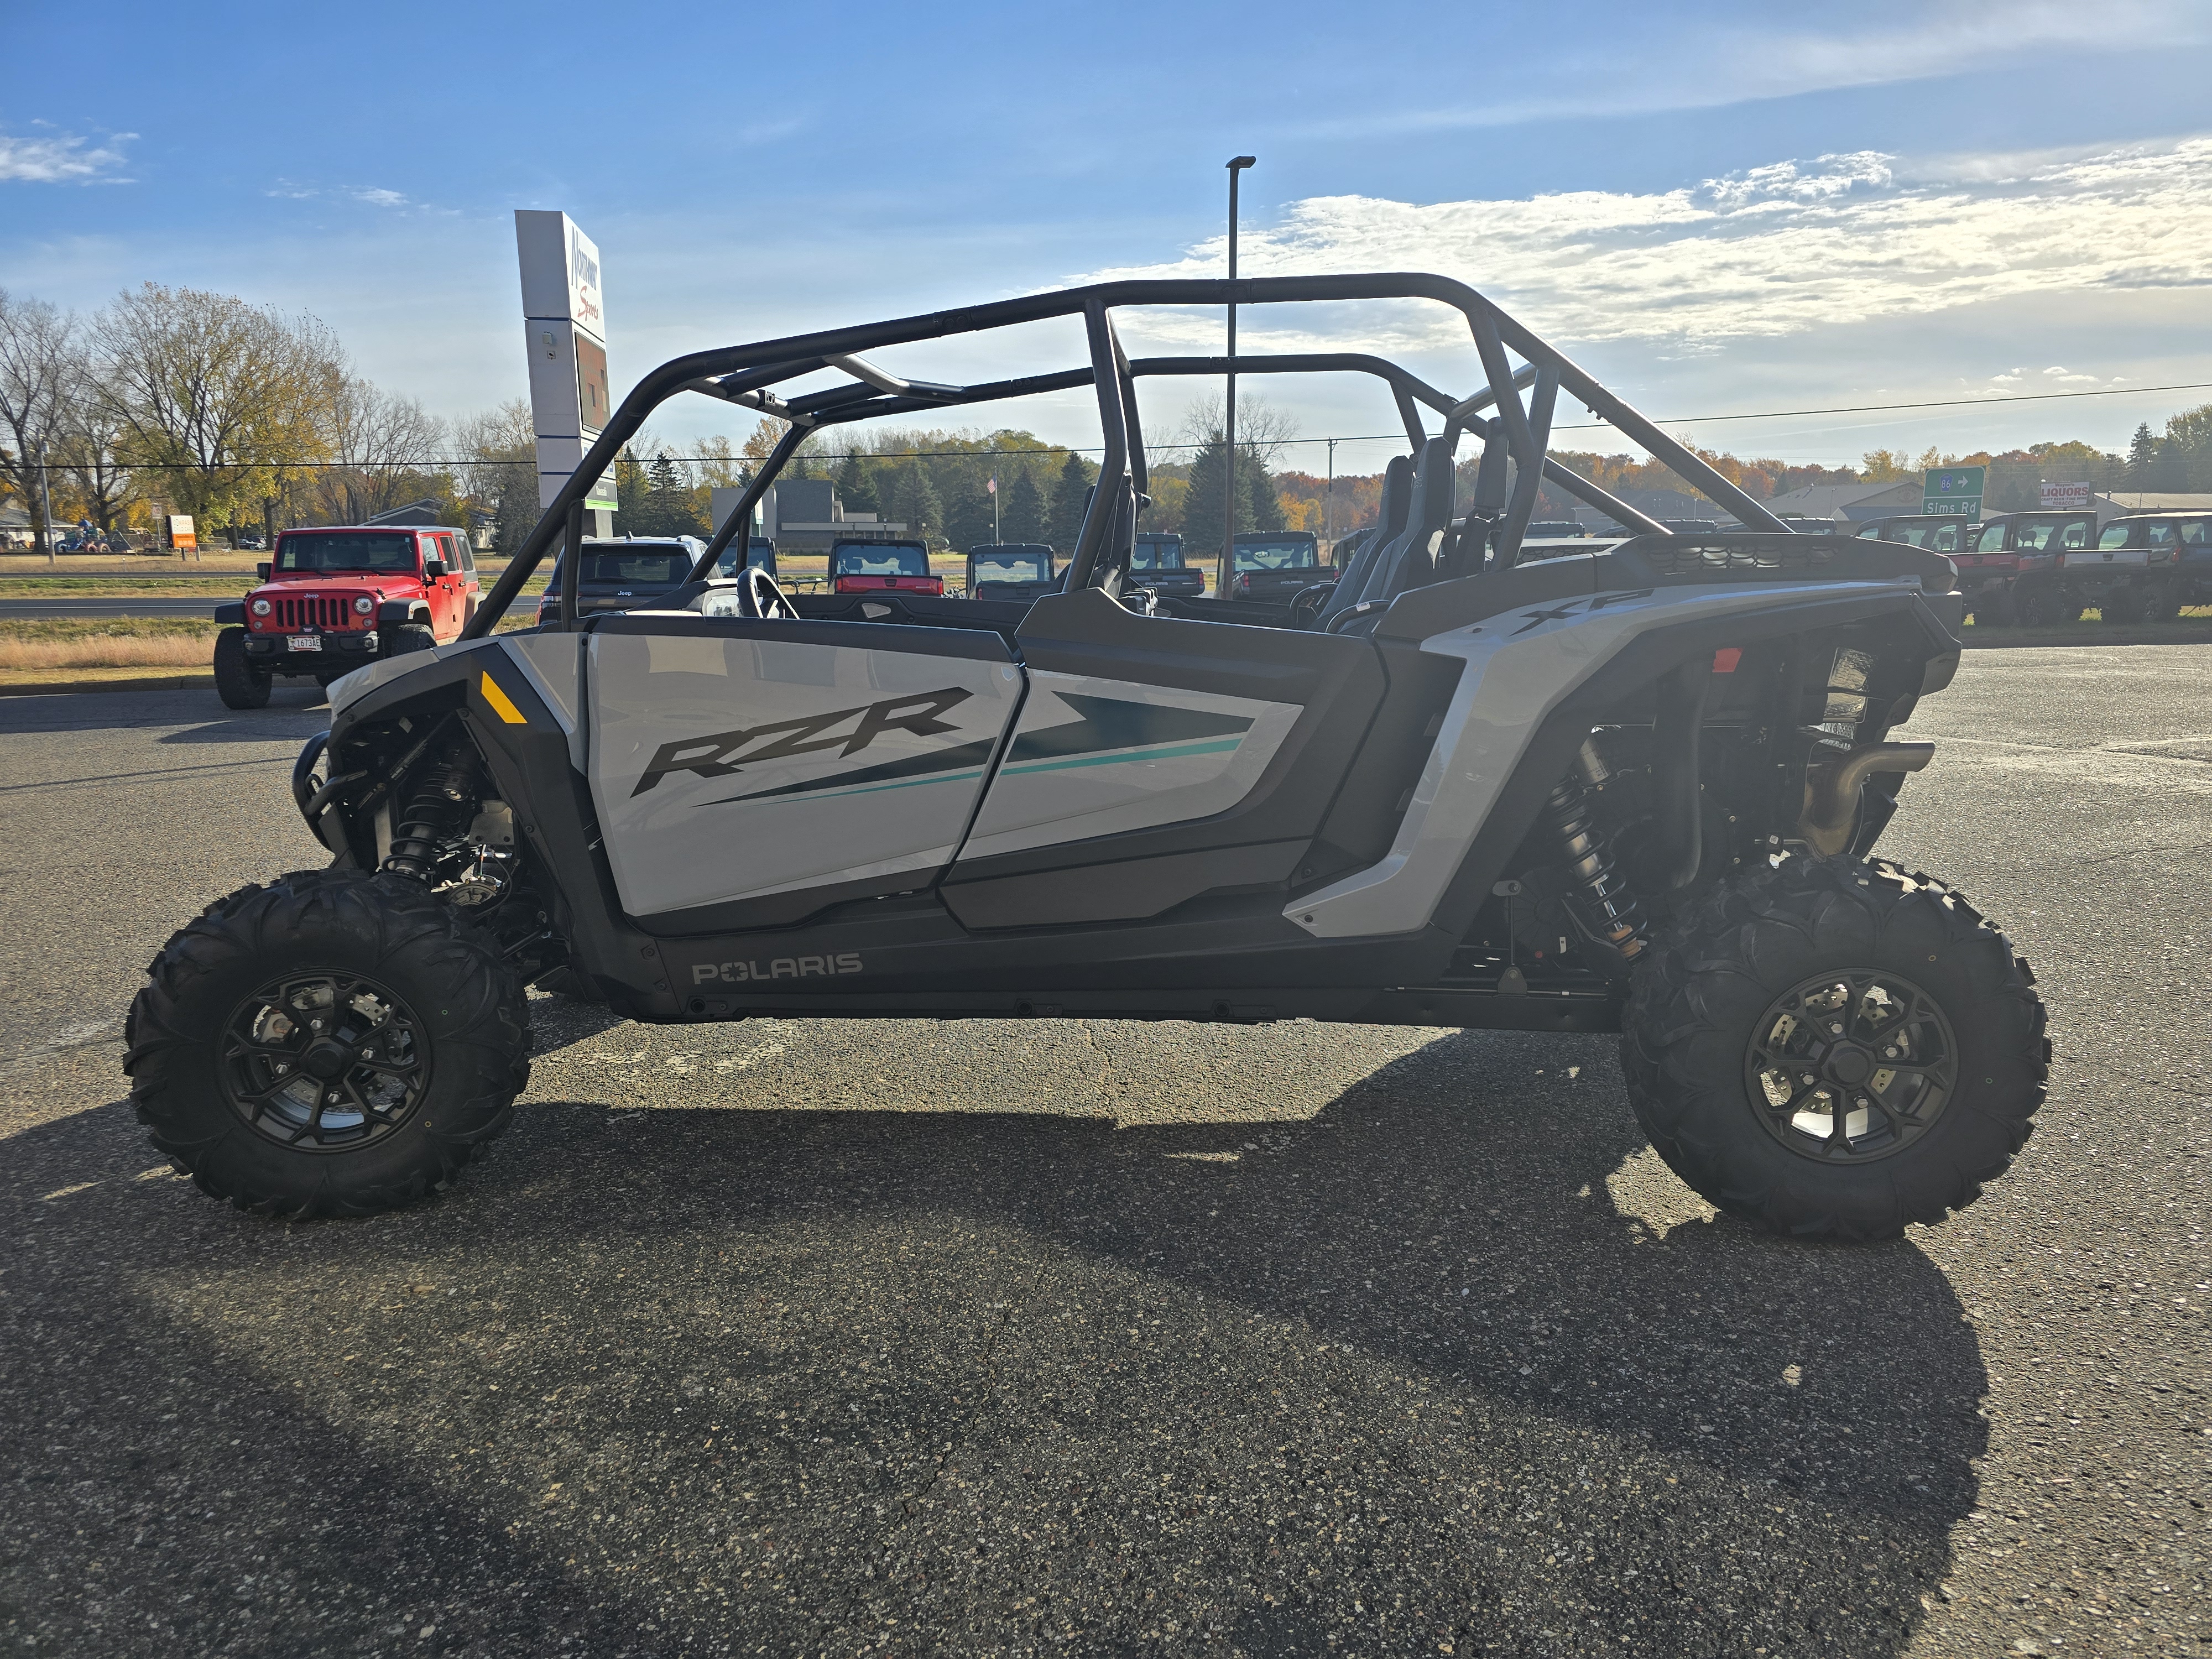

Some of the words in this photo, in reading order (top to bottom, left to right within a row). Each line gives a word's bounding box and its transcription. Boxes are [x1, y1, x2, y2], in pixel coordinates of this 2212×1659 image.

[577, 285, 598, 322] Sports
[1941, 479, 1950, 488] 86
[2042, 487, 2088, 497] LIQUORS
[1927, 503, 1955, 514] Sims
[1961, 502, 1976, 513] Rd
[296, 639, 320, 647] 1673AE
[629, 686, 974, 799] RZR
[692, 953, 863, 985] POLARIS
